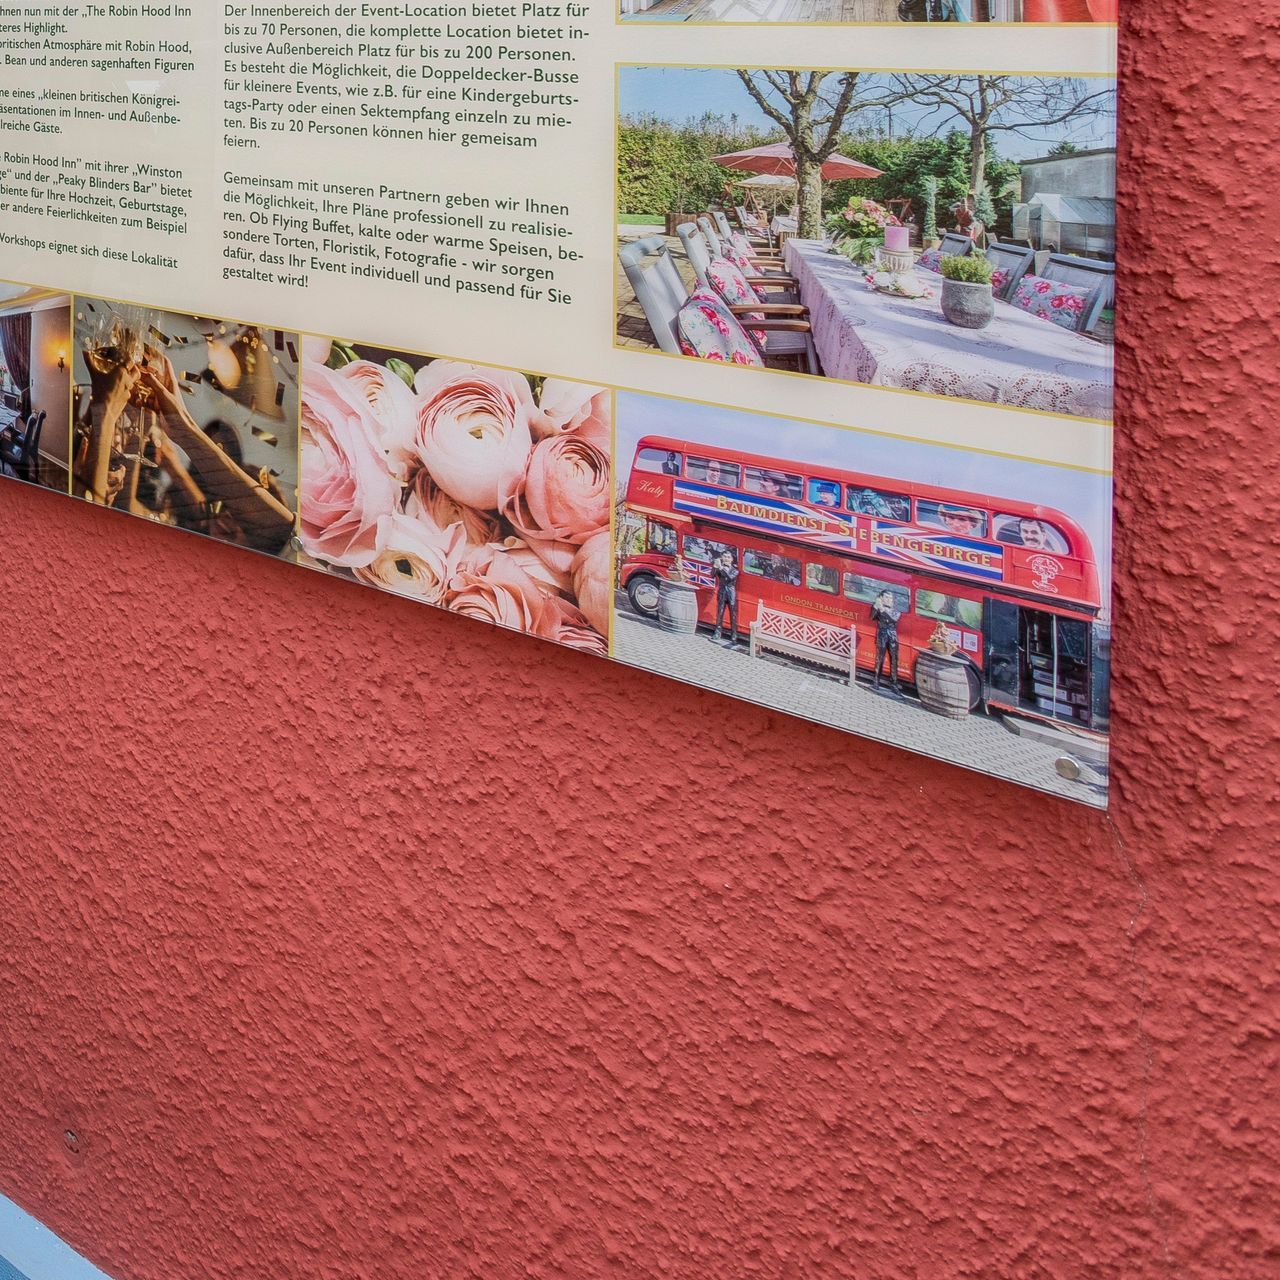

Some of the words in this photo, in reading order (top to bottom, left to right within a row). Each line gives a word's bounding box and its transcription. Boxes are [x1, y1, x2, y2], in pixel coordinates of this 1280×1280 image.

[23, 21, 67, 36] Highlight.
[223, 78, 240, 90] für
[243, 79, 291, 93] kleinere
[296, 80, 341, 97] Events,
[344, 83, 368, 96] wie
[373, 84, 397, 97] z.B.
[401, 84, 422, 98] für
[426, 86, 456, 100] eine
[461, 87, 578, 107] Kindergeburts-
[32, 121, 62, 133] Gäste.
[223, 171, 293, 189] Gemeinsam
[297, 179, 318, 191] mit
[322, 183, 374, 197] unseren
[379, 184, 440, 203] Partnern
[445, 192, 489, 208] geben
[494, 196, 519, 211] wir
[525, 197, 568, 215] Ihnen
[222, 245, 255, 263] dafür,
[258, 250, 284, 265] dass
[288, 253, 306, 267] Ihr
[310, 256, 346, 273] Event
[351, 262, 418, 283] individuell
[424, 274, 450, 288] und
[455, 279, 514, 296] passend
[519, 284, 542, 300] für
[547, 287, 571, 304] Sie
[716, 495, 828, 532] BAUMDIENST
[839, 520, 992, 566] SIEBENGEBIRGE
[780, 594, 813, 609] LONDON
[815, 602, 860, 618] TRANSPORT
